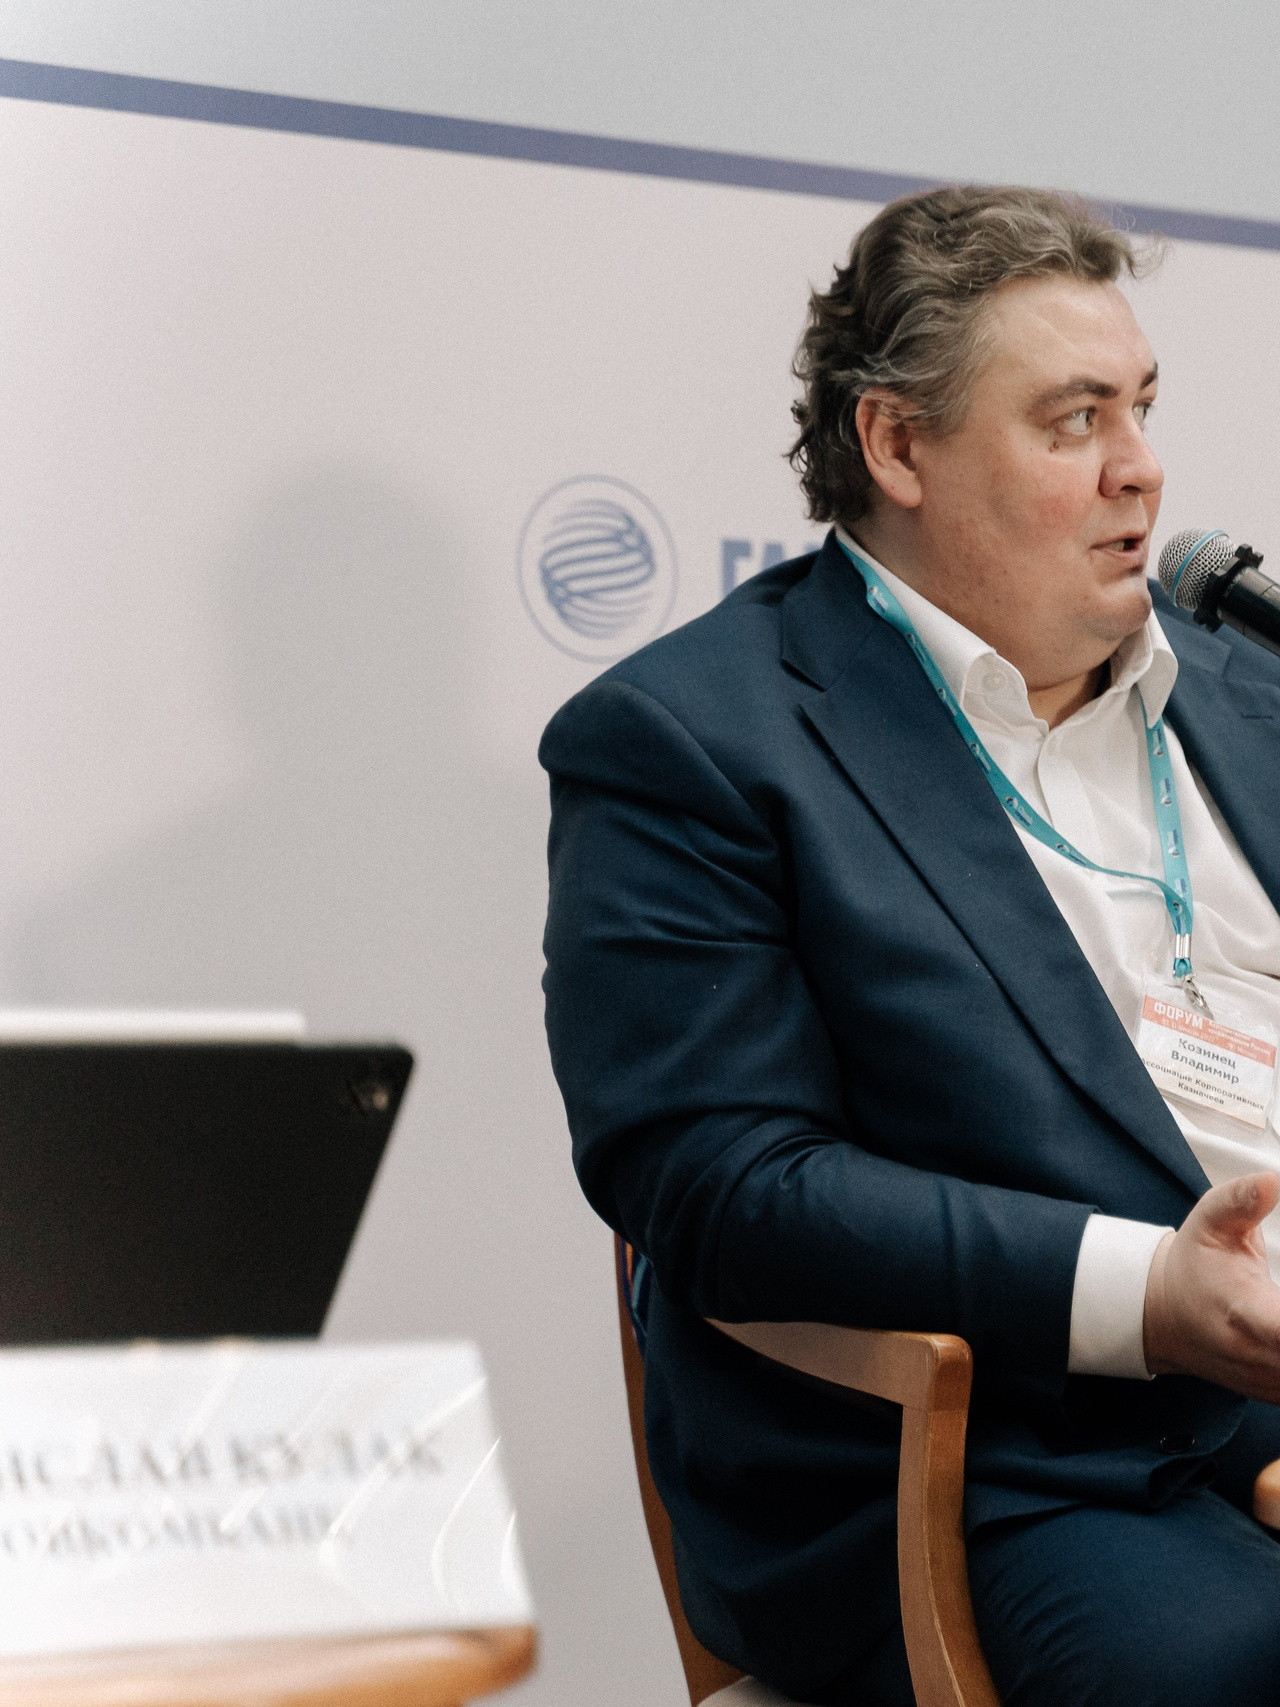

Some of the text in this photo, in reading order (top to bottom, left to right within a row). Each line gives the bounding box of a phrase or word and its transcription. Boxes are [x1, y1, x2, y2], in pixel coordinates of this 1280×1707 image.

[1154, 1001, 1203, 1029] ФОРУМ
[1171, 1050, 1239, 1084] Владимир
[1179, 1038, 1236, 1069] Козинец
[1178, 1081, 1224, 1105] Казначеев
